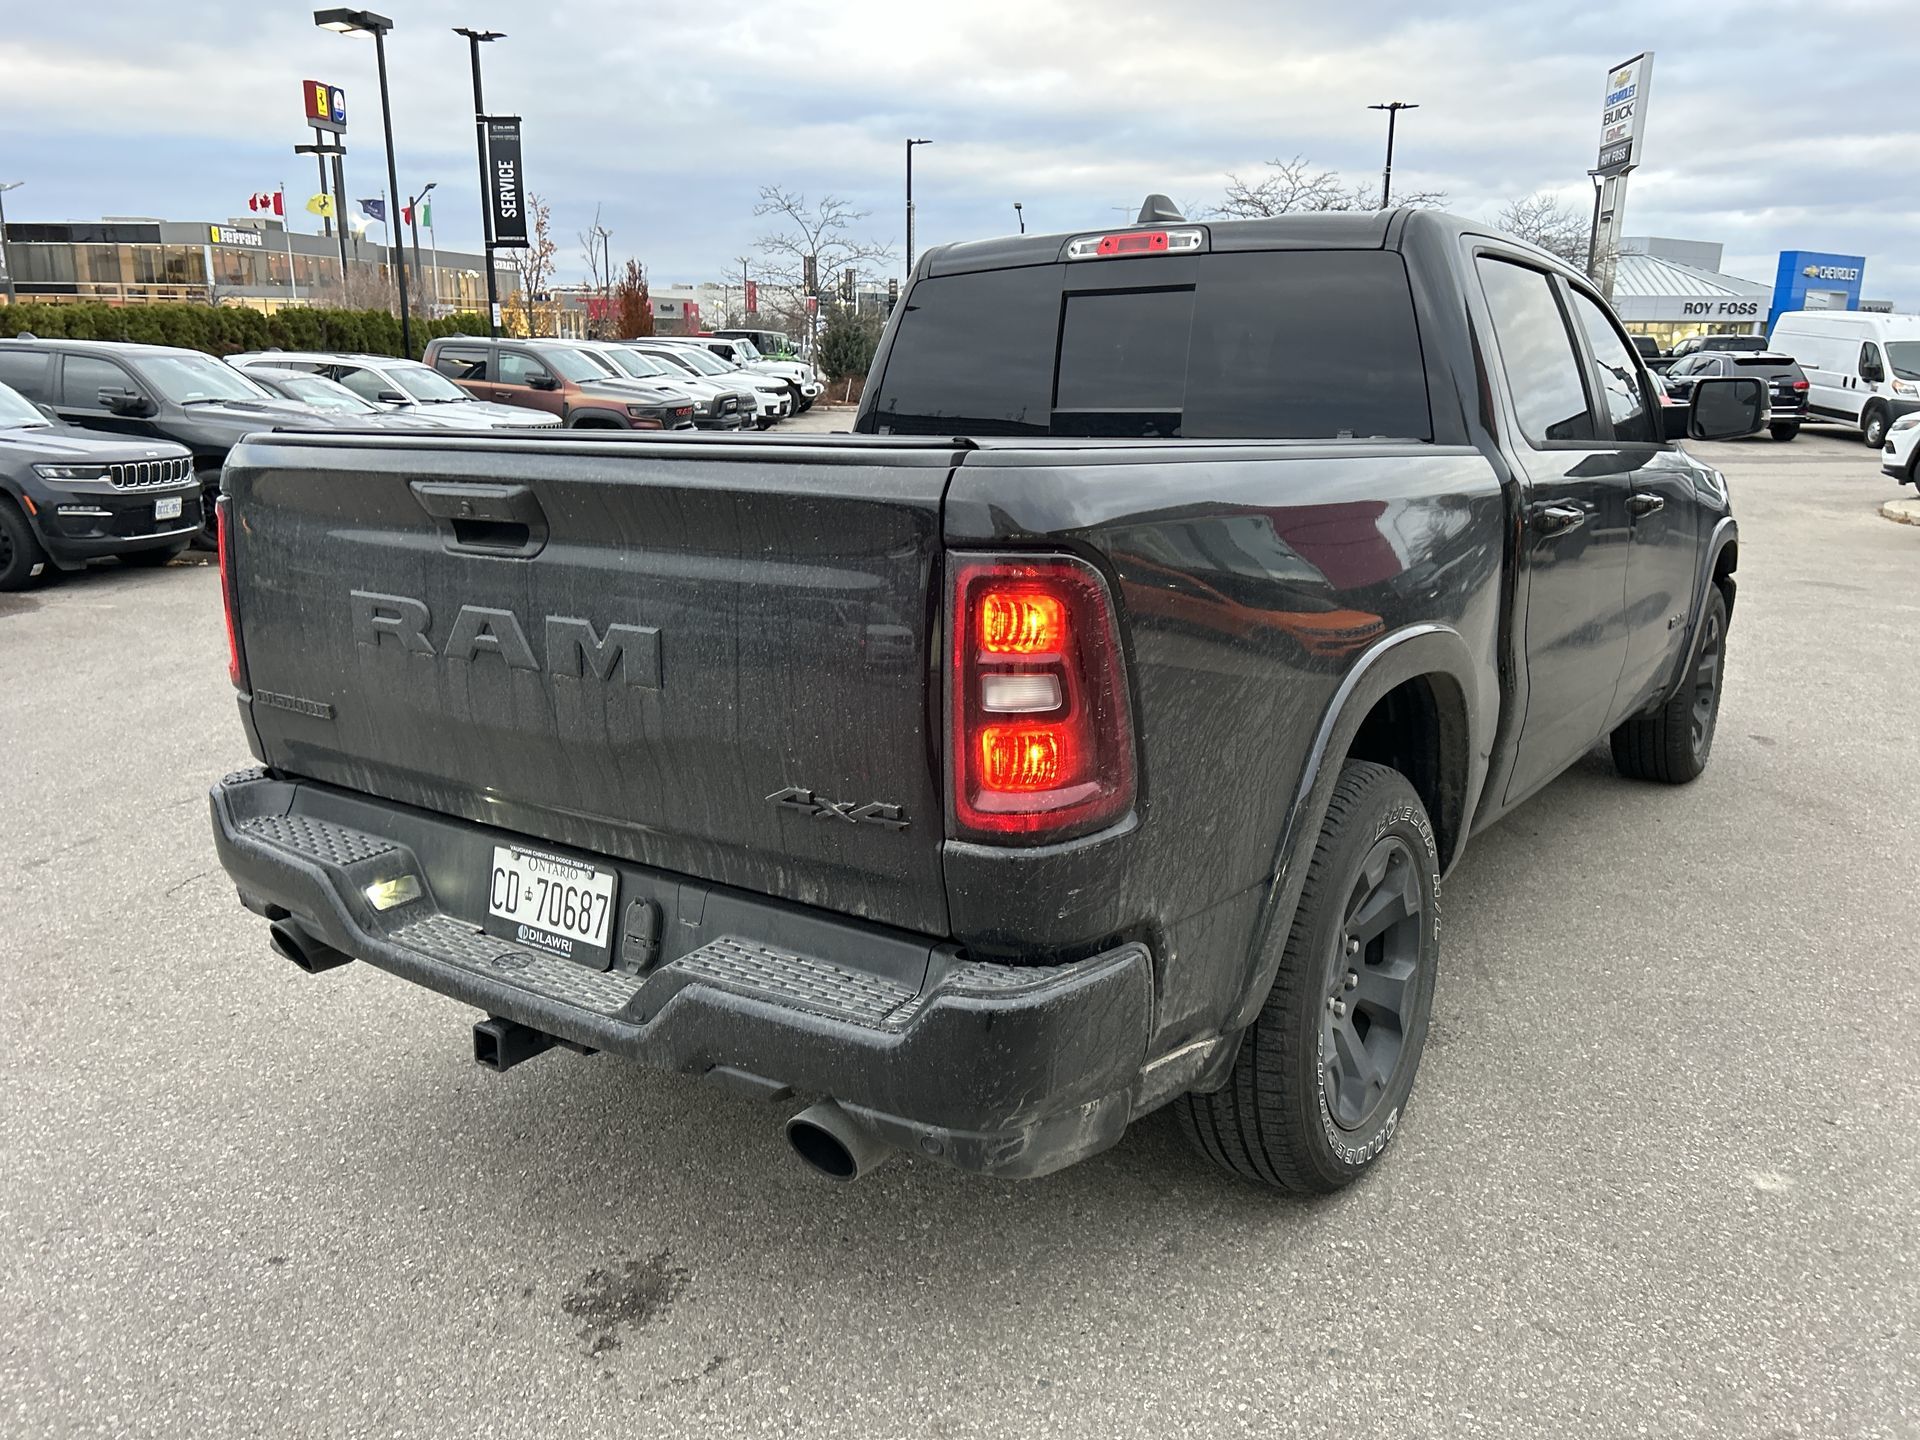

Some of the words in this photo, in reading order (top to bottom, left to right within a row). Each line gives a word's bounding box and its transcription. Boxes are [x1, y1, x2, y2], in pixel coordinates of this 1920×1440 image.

[1607, 84, 1636, 107] CHEVROLET
[1603, 103, 1634, 126] BUICK
[1606, 124, 1626, 142] GMC
[1601, 152, 1611, 166] ROY
[1612, 147, 1627, 162] FOSS
[498, 160, 517, 218] SERVICE
[220, 226, 262, 246] Ferrari
[1819, 265, 1859, 281] CHEVROLET
[1684, 302, 1713, 315] ROY
[1718, 302, 1758, 315] FOSS
[350, 589, 664, 690] RAM
[1374, 806, 1435, 858] DUELER
[510, 844, 532, 855] VAUGHAN
[532, 850, 556, 861] CHRYSLER
[556, 855, 572, 866] DODGE
[572, 860, 583, 869] JEEP
[584, 863, 595, 872] FIAT
[528, 857, 579, 881] ONTARIO
[492, 867, 520, 914] CD
[536, 877, 609, 939] 70687
[528, 929, 573, 953] DILAWRI
[1317, 1030, 1398, 1165] BRIDGESTONE
